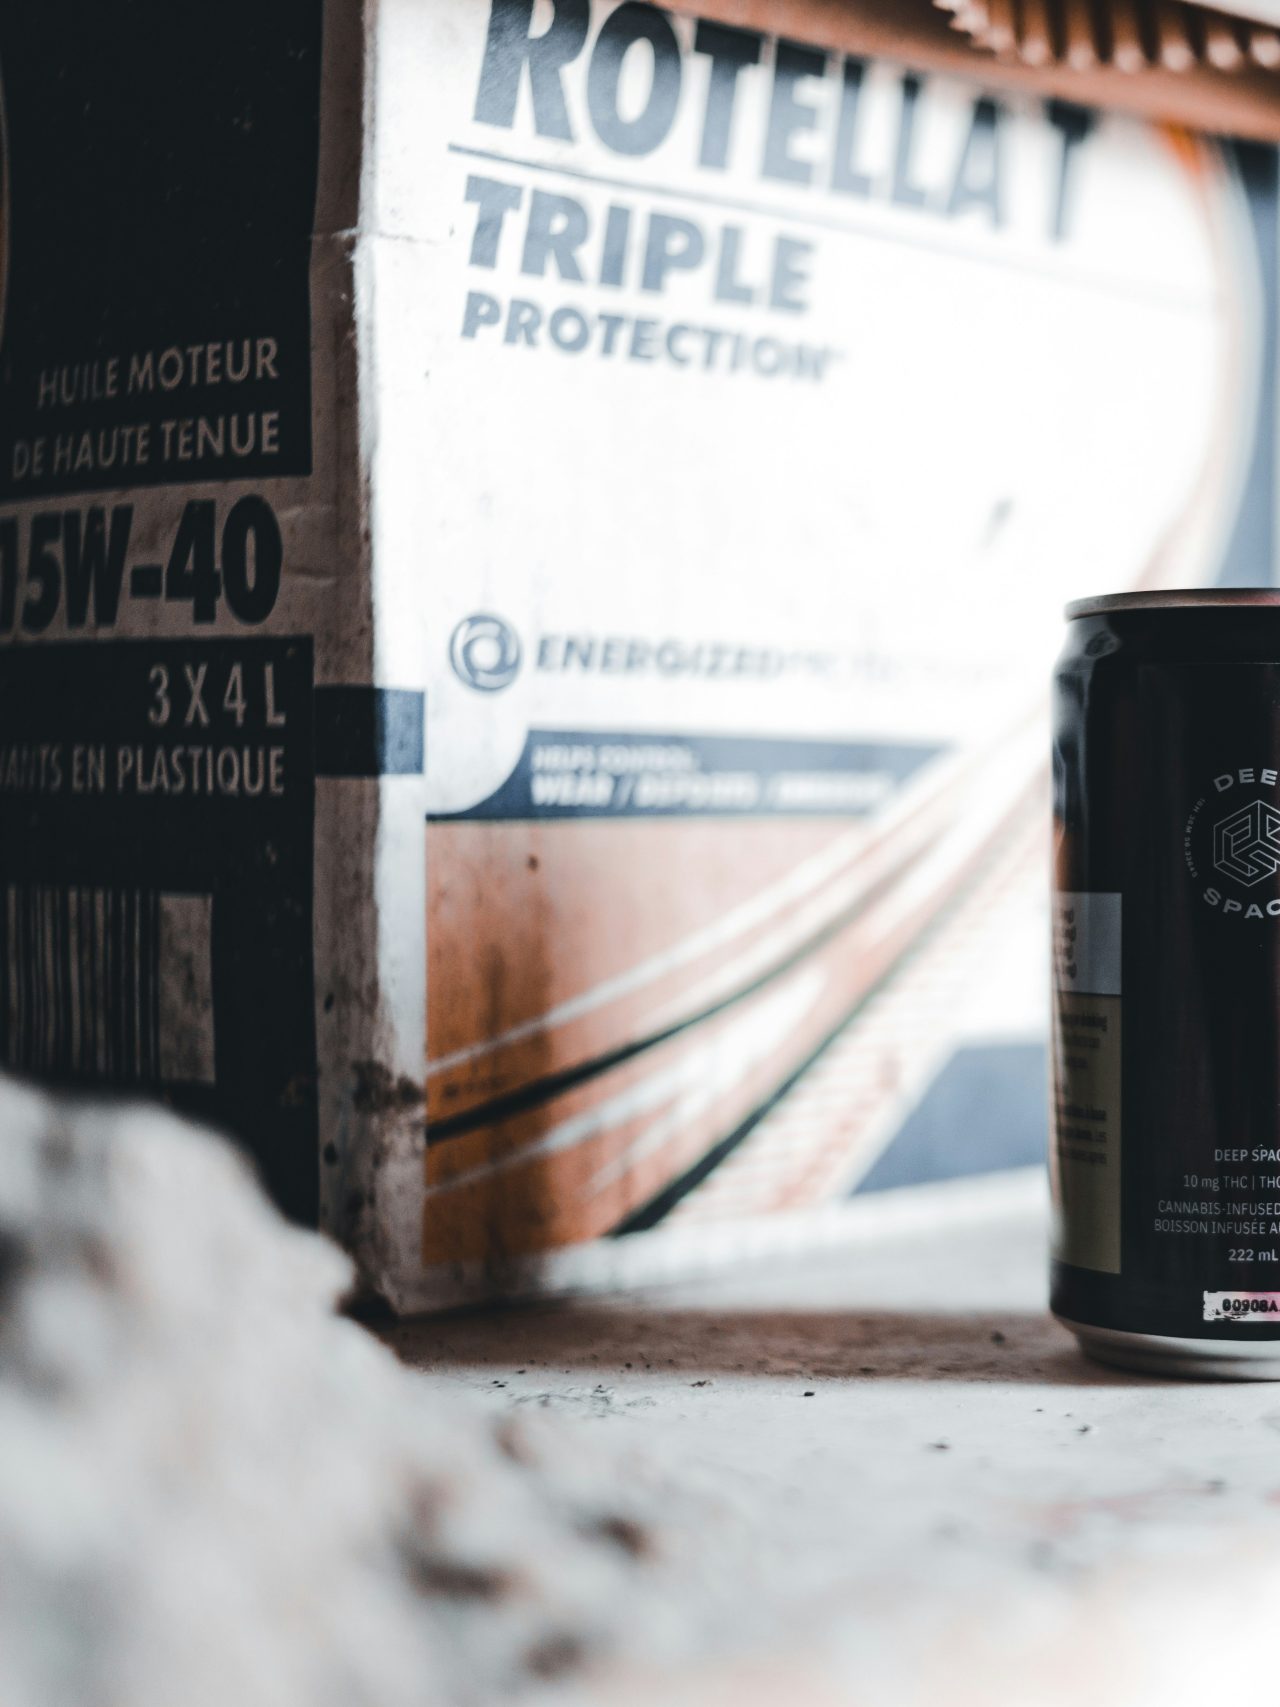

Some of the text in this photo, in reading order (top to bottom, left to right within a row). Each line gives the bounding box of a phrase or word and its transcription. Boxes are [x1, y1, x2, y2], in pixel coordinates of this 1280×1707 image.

[464, 173, 819, 312] TRIPLE
[38, 336, 279, 408] HUILE MOTEUR
[12, 411, 280, 479] DE HAUTE TENUE
[147, 663, 286, 727] 3 X 4 L
[71, 745, 106, 795] EN
[117, 745, 285, 797] PLASTIQUE
[1214, 1148, 1248, 1162] DEEP
[1183, 1174, 1198, 1188] 10
[1201, 1176, 1220, 1191] mg
[1223, 1175, 1248, 1188] THC
[1154, 1218, 1208, 1234] BOISSON
[1211, 1218, 1266, 1235] INFUSÉE
[1228, 1248, 1279, 1262] 222 mL
